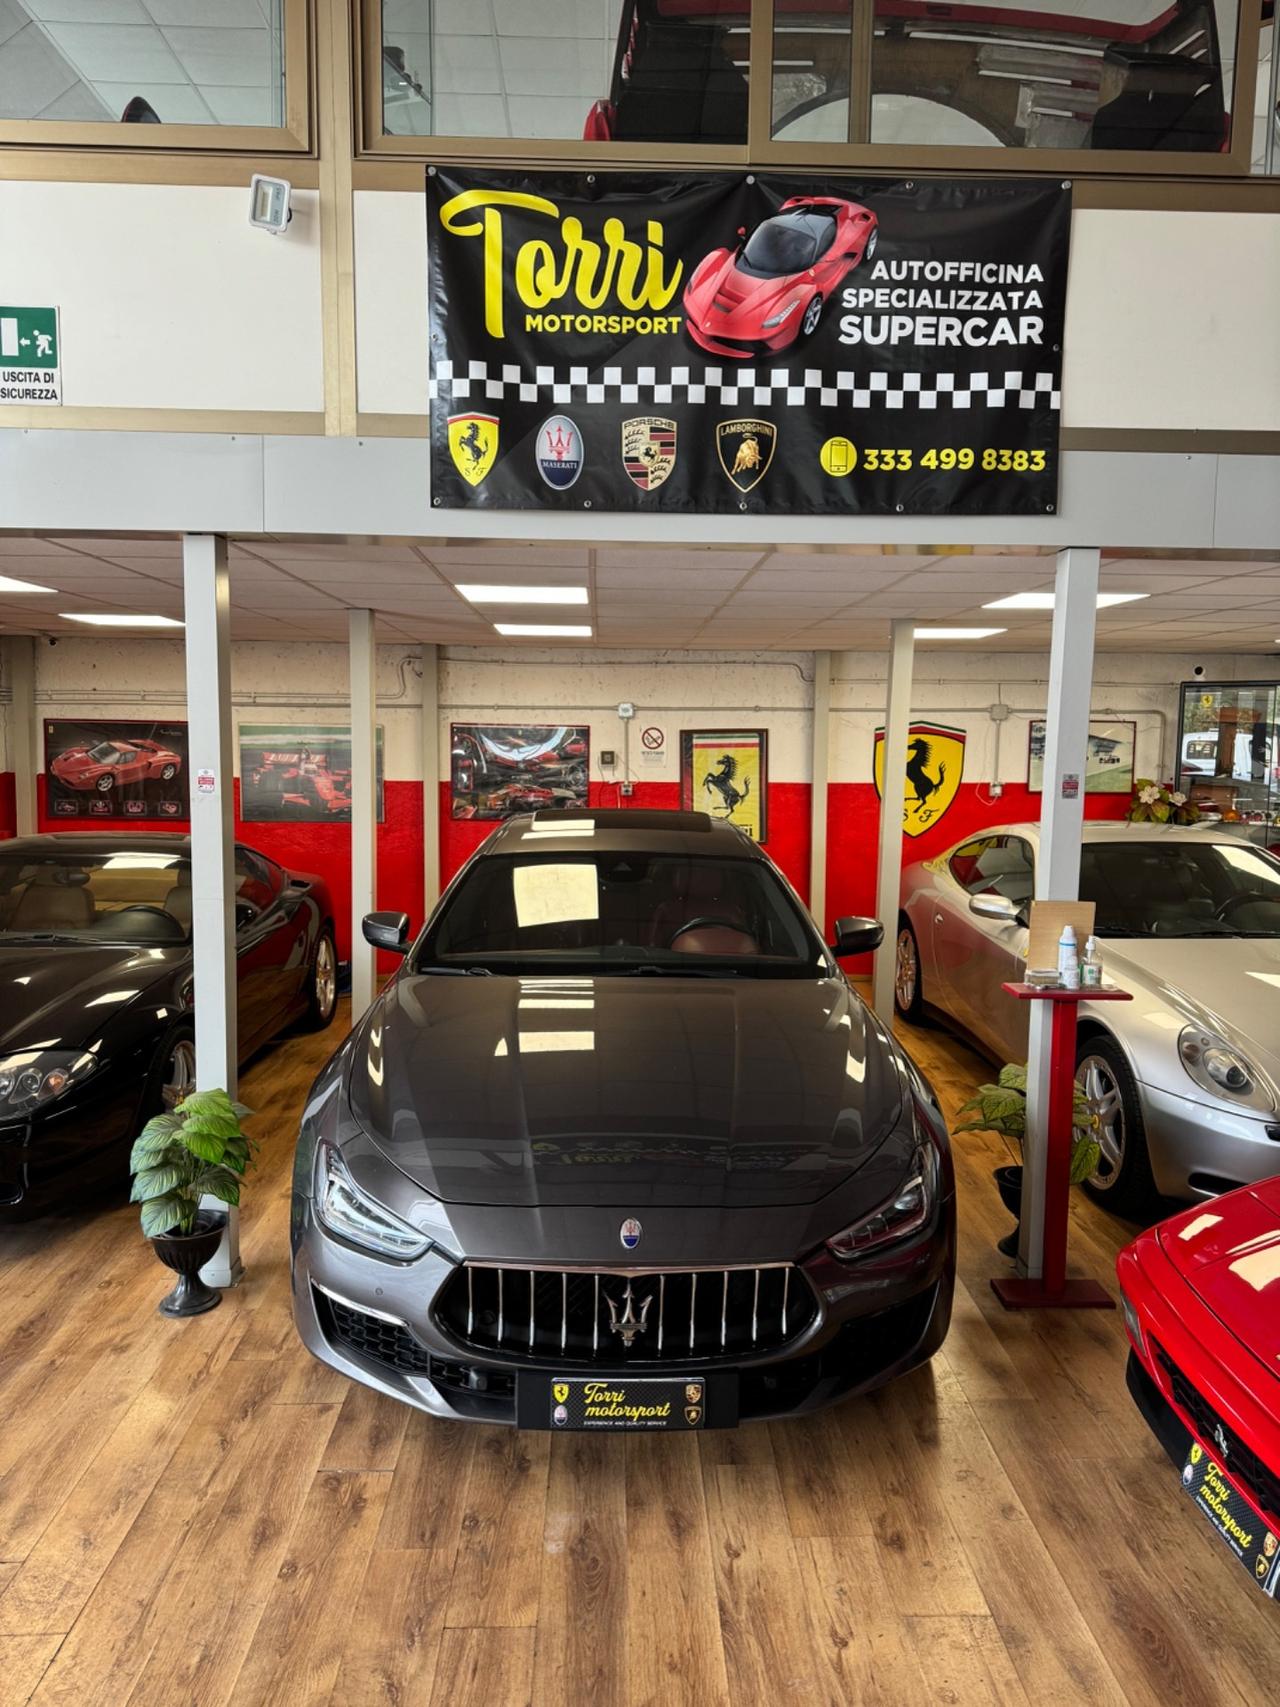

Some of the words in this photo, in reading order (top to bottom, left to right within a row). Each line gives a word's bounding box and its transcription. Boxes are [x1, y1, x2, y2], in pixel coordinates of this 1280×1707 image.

[440, 189, 684, 338] Torri
[870, 259, 1045, 284] AUTOFFICINA
[841, 287, 1044, 311] SPECIALIZZATA
[525, 314, 682, 335] MOTORSPORT
[838, 315, 1044, 347] SUPERCAR
[2, 371, 41, 383] USCITA
[43, 372, 55, 384] DI
[0, 387, 58, 400] SICUREZZA
[624, 418, 675, 430] PORSCHE
[720, 422, 773, 437] LAMBORGHINI
[542, 461, 577, 469] MASERATI
[863, 449, 913, 471] 333
[920, 448, 975, 470] 499
[981, 448, 1046, 471] 8383
[583, 1383, 625, 1404] Torri
[585, 1402, 671, 1421] motorsport
[1204, 1463, 1230, 1501] Torri
[1199, 1485, 1253, 1548] motorsport
